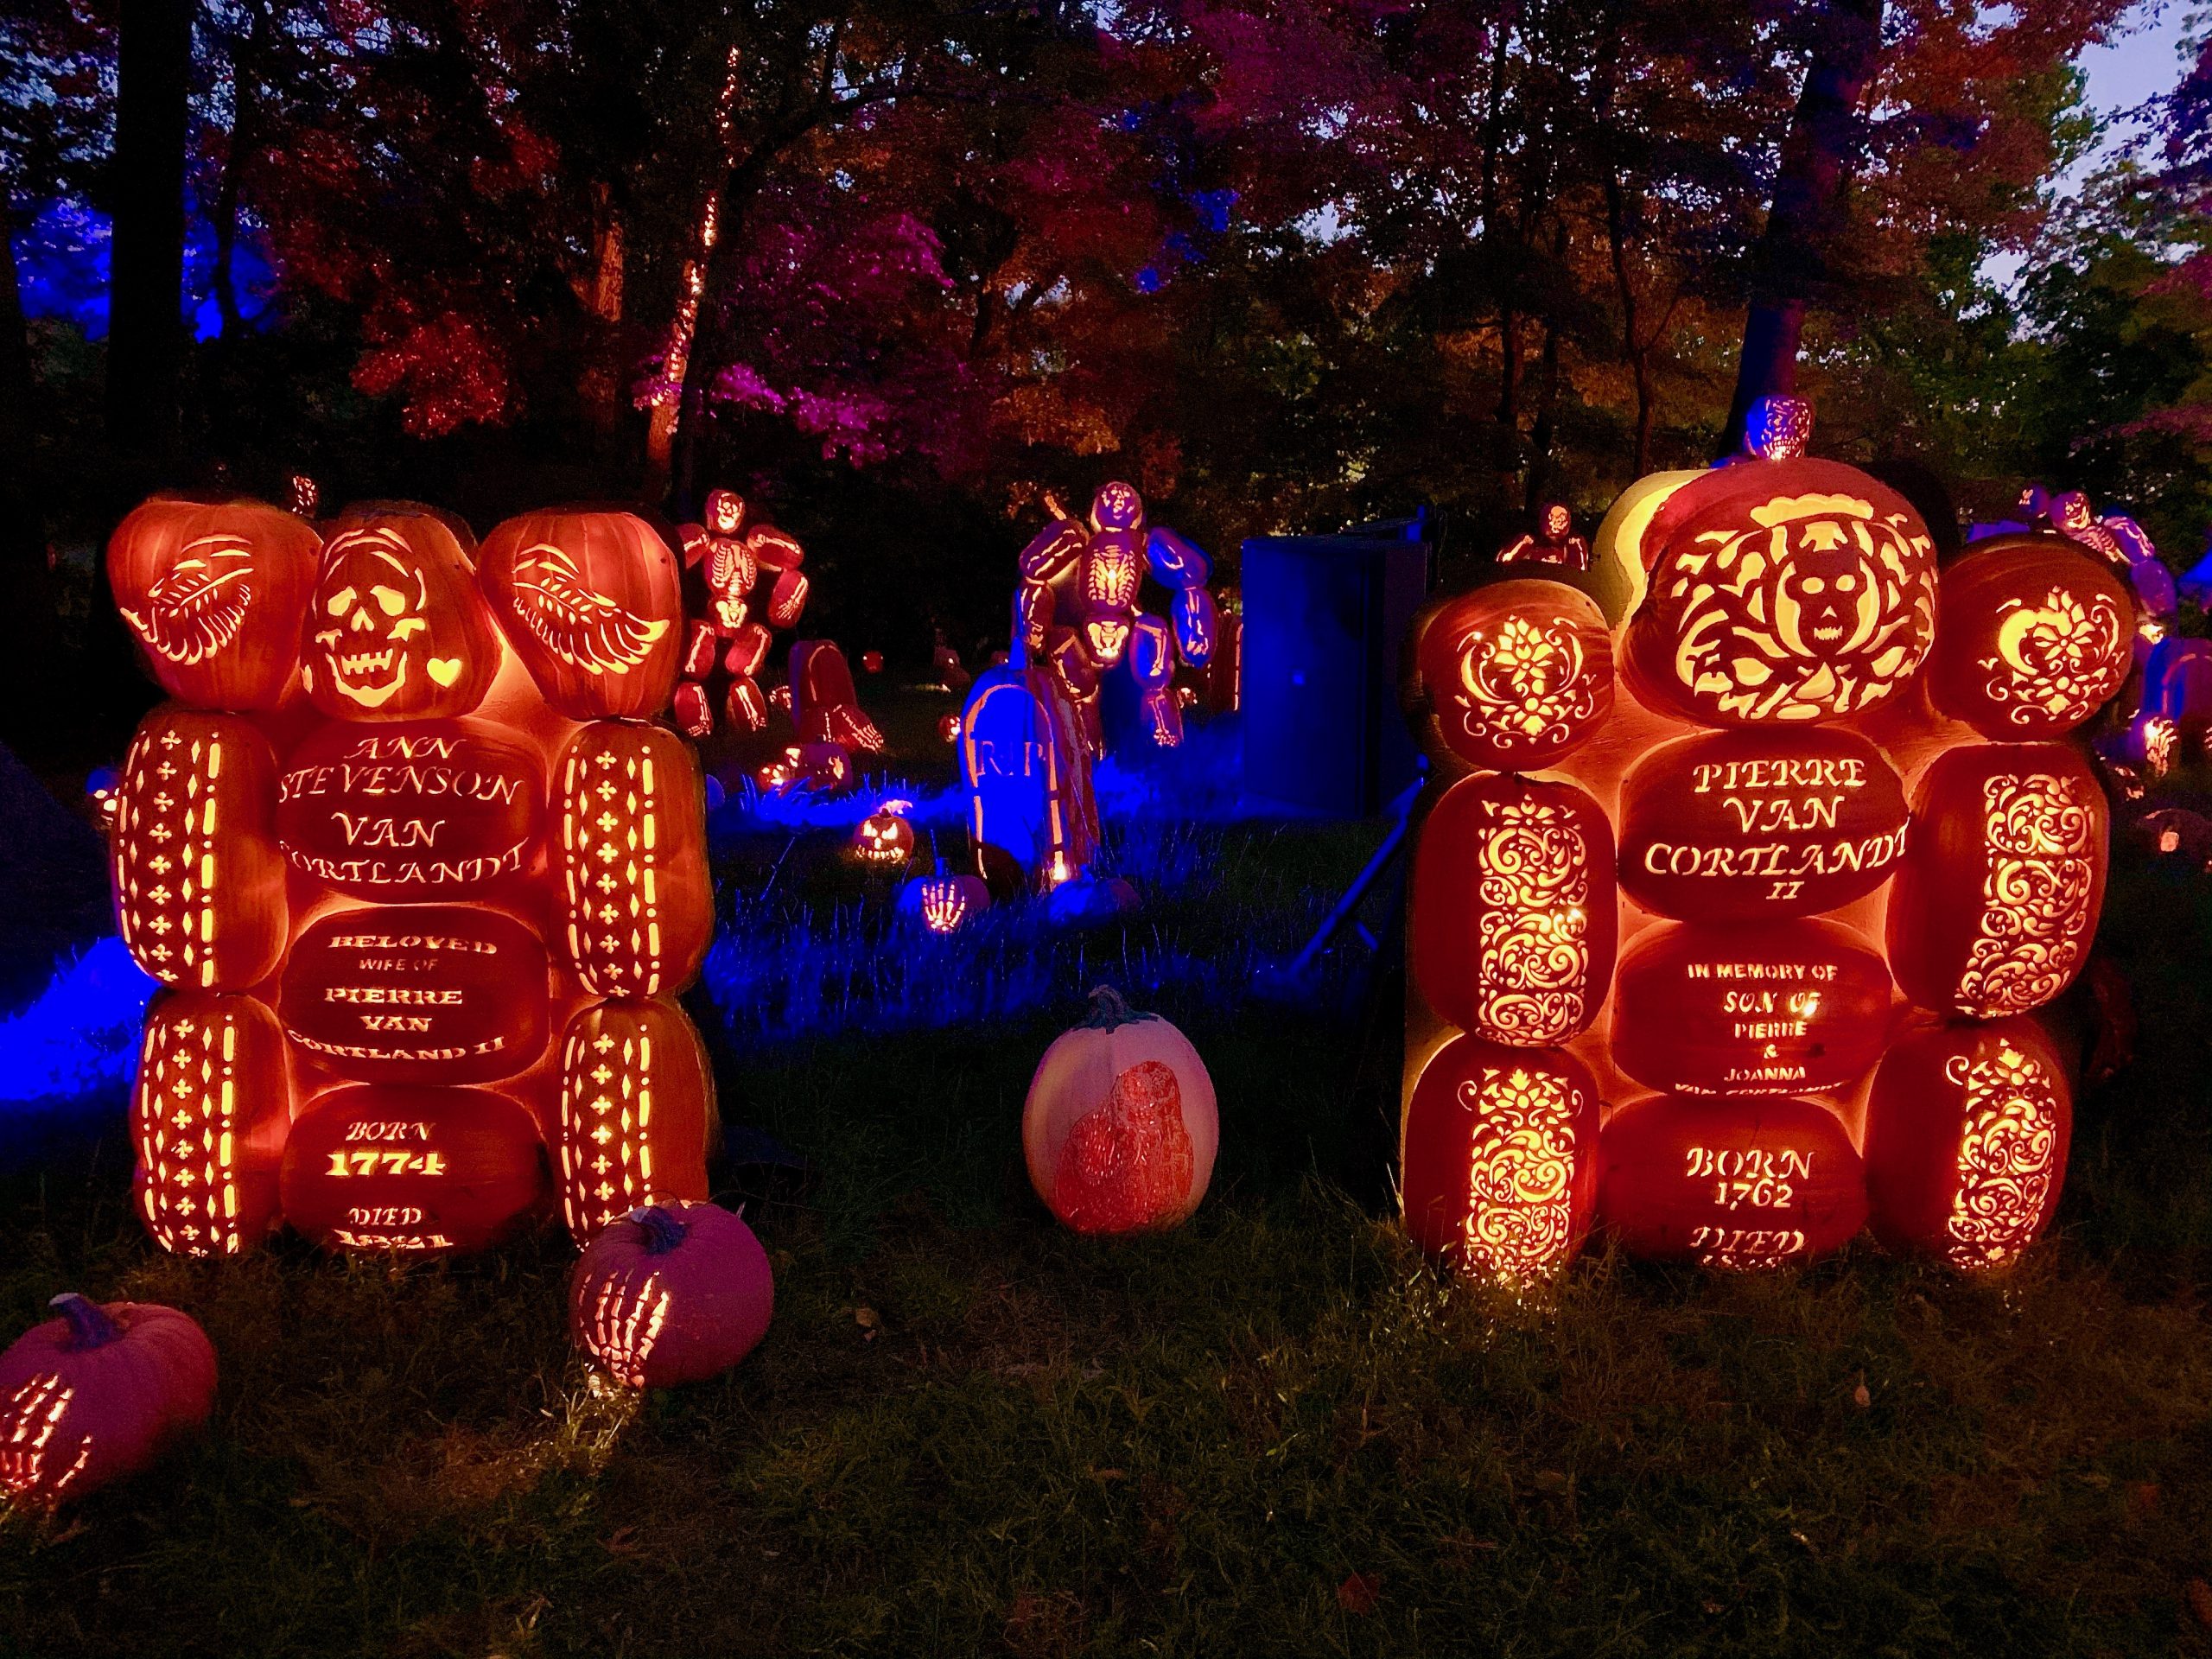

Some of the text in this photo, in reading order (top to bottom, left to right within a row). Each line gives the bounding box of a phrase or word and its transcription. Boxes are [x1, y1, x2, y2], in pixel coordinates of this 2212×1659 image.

[343, 736, 467, 759] ANN
[278, 763, 525, 804] STEVENSON
[1693, 759, 1866, 793] PIERRE
[1723, 796, 1845, 833] VAN
[330, 812, 445, 848] VAN
[328, 935, 498, 955] BELOVED
[359, 958, 439, 971] WIFE OF
[1688, 963, 1838, 981] IN MEMORY OF
[324, 988, 463, 1005] PIERRE
[1723, 991, 1821, 1017] SON OF
[359, 1015, 432, 1032] VAN
[1764, 1044, 1778, 1058] &
[1724, 1066, 1806, 1081] JOANNA
[346, 1122, 436, 1141] BORN
[325, 1152, 446, 1176] 1774
[1687, 1147, 1814, 1179] BORN
[1714, 1178, 1793, 1211] 1762
[348, 1207, 422, 1226] DIED
[1689, 1226, 1805, 1255] DIED
